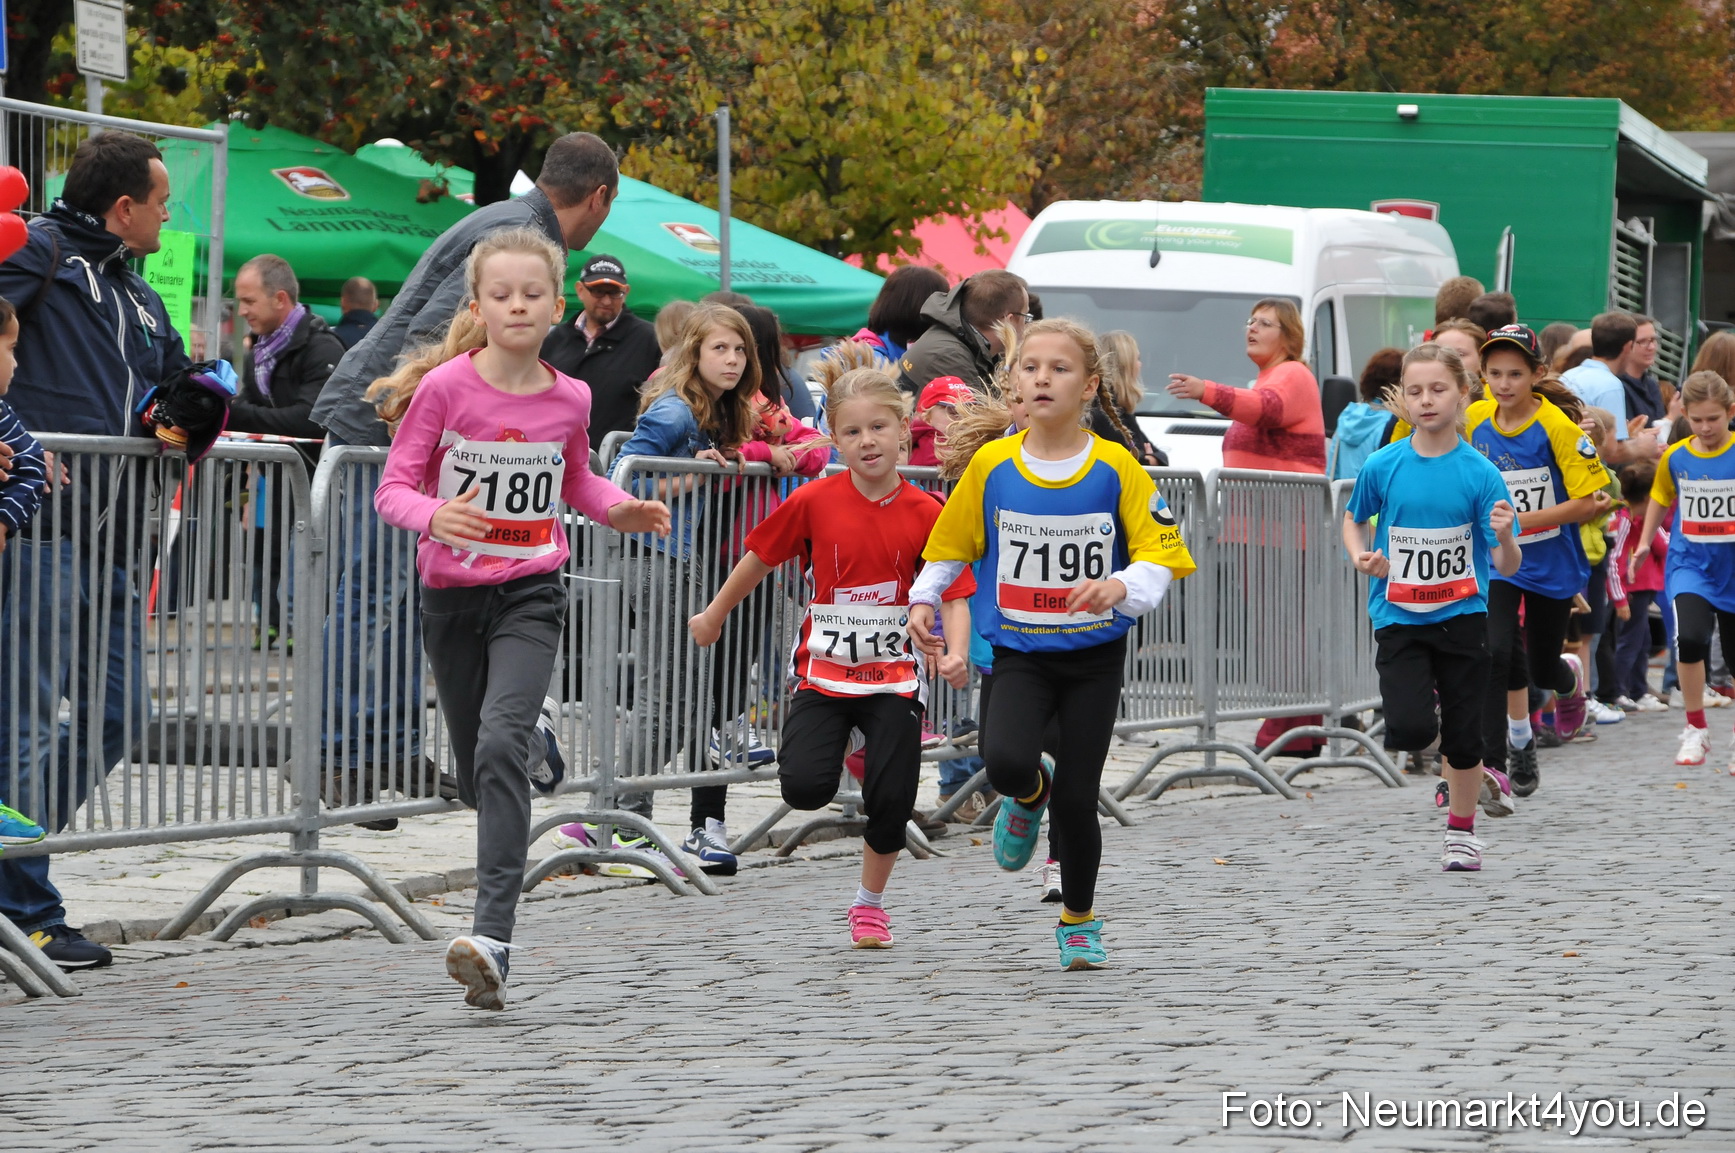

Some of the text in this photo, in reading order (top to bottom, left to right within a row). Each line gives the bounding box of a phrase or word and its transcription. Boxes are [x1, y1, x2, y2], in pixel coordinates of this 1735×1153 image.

[1154, 224, 1237, 236] Europcar
[1139, 236, 1185, 246] moving
[489, 453, 548, 466] Neumarkt
[1506, 477, 1538, 487] eumarkt
[453, 465, 553, 515] 7180
[1700, 486, 1734, 494] Neumarkt
[1684, 494, 1735, 519] 7020
[1001, 521, 1095, 537] PARTL Neumarkt
[1698, 524, 1725, 534] Maria
[1391, 534, 1463, 546] PARTL Neumarkt
[1009, 539, 1105, 583] 7196
[1398, 545, 1467, 581] 7063
[850, 590, 880, 602] DEHN
[1033, 592, 1067, 609] Elen
[1411, 587, 1455, 601] Tamina
[813, 614, 896, 626] PARTL Neumarkt
[1000, 620, 1113, 635] www.stadtlauf-neumarkt.de
[822, 630, 903, 664] 7113
[845, 667, 885, 682] Paula
